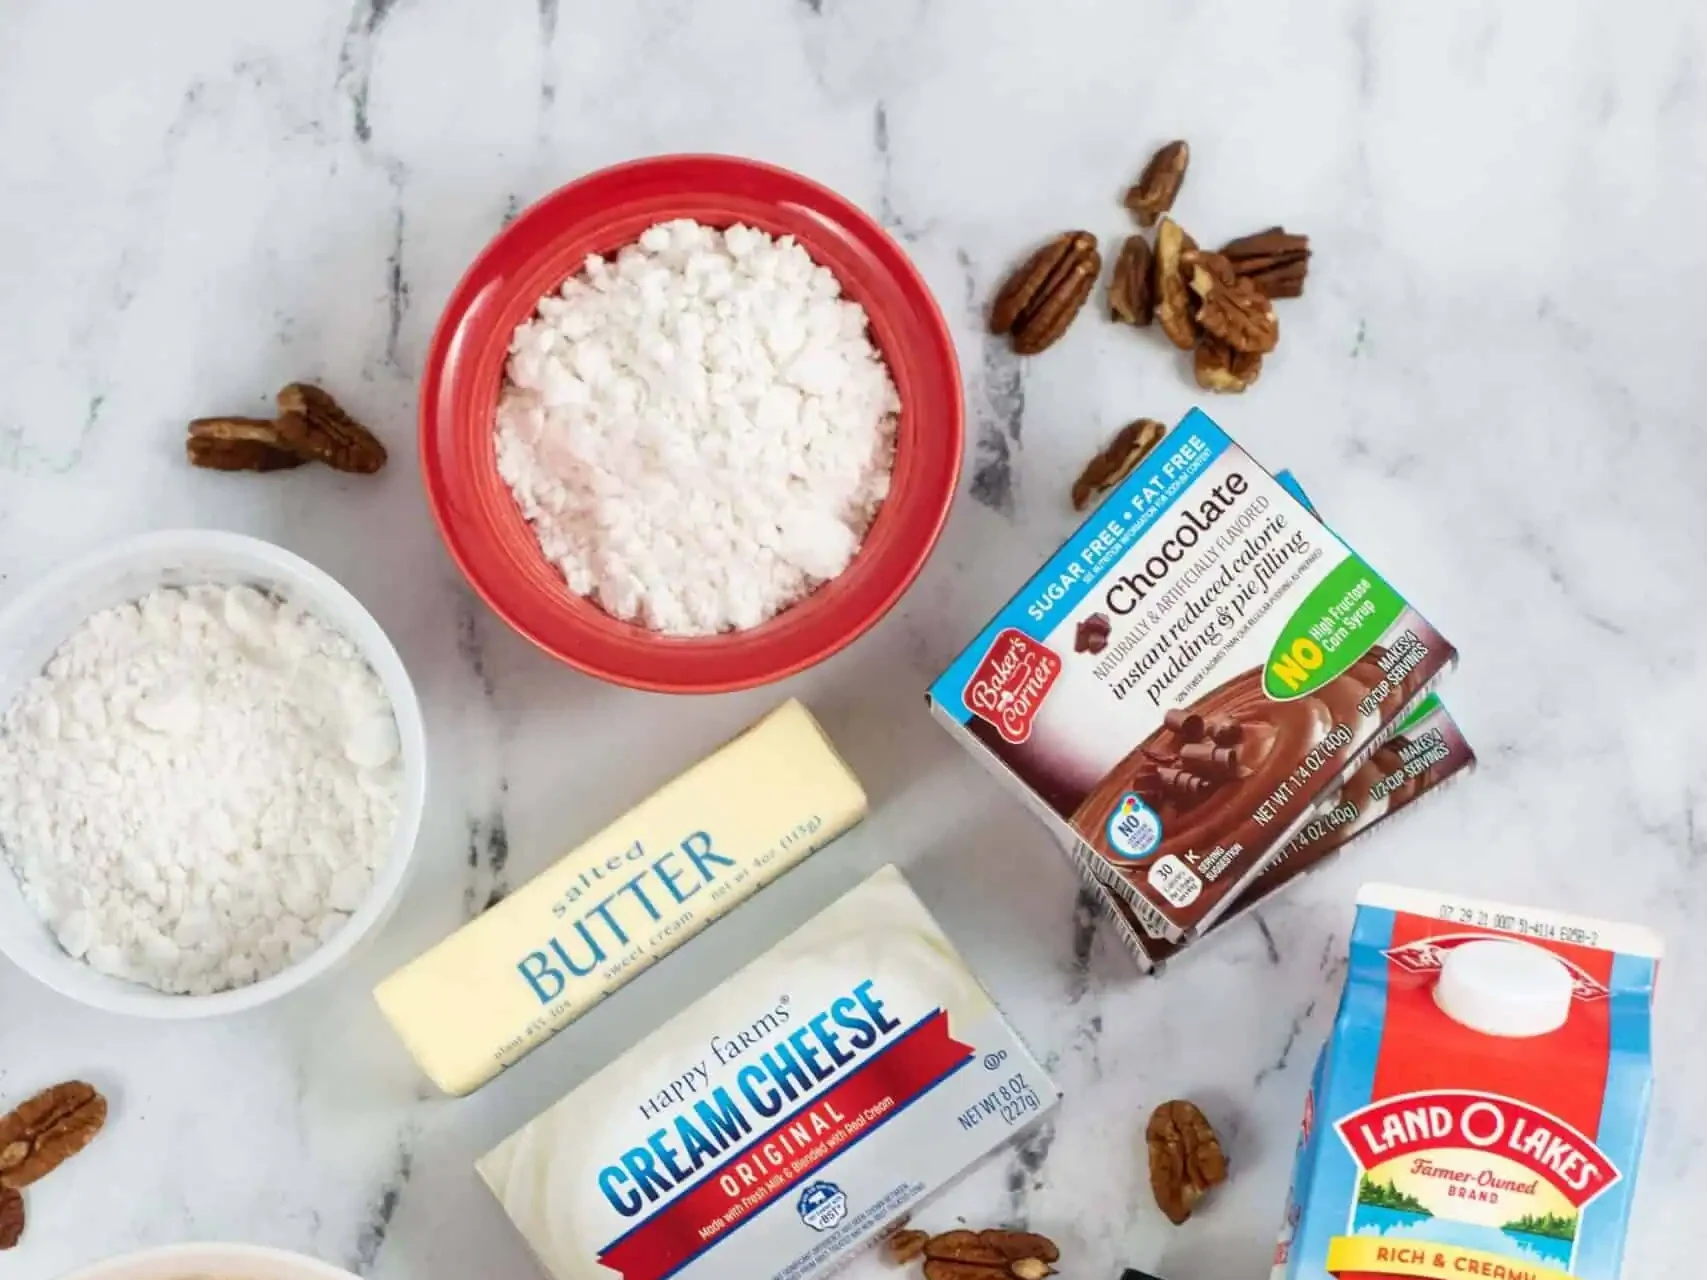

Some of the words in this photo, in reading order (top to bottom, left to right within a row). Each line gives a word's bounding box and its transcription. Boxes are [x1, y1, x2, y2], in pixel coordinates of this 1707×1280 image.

[1027, 561, 1086, 621] SUGAR
[1081, 520, 1125, 565] FREE
[1131, 475, 1166, 512] FAT
[1161, 434, 1206, 479] FREE
[1106, 472, 1248, 615] Chocolate
[1093, 621, 1150, 681] NATURALLY
[1149, 608, 1163, 625] &
[1158, 545, 1219, 612] ARTIFICIALLY
[1215, 495, 1270, 553] FLAVORED
[1108, 635, 1171, 701] instant
[1169, 565, 1234, 643] reduced
[1232, 512, 1289, 576] calorie
[1146, 620, 1225, 707] pudding
[1216, 605, 1235, 630] &
[1230, 582, 1261, 617] pie
[1256, 531, 1311, 594] filling
[1308, 614, 1336, 641] High
[1328, 578, 1372, 624] Fructose
[1322, 624, 1353, 653] Corn
[1348, 600, 1376, 635] Syrup
[1377, 635, 1411, 673] MAKES
[972, 637, 1026, 711] Baker's
[1003, 655, 1052, 736] Corner
[1272, 637, 1324, 691] NO
[1390, 642, 1429, 686] SERVINGS
[1252, 799, 1277, 827] NET
[1270, 783, 1295, 808] WT
[1289, 766, 1312, 791] 1.4
[1305, 751, 1327, 774] OZ
[1320, 724, 1353, 759] (40g)
[1400, 732, 1436, 764] MAKES
[1403, 742, 1451, 779] SERVINGS
[1116, 814, 1141, 838] NO
[1306, 820, 1329, 843] OZ
[1324, 801, 1360, 832] (40g)
[551, 839, 646, 919] salted
[1155, 862, 1174, 881] 30
[516, 830, 737, 1005] BUTTER
[597, 1086, 753, 1218] CREAM
[736, 978, 902, 1118] CHEESE
[957, 1104, 984, 1130] NET
[978, 1091, 1002, 1115] WT
[999, 1085, 1012, 1101] 8
[1008, 1073, 1029, 1094] OZ
[1000, 1089, 1041, 1126] (227g)
[698, 1217, 728, 1241] Made
[723, 1202, 746, 1223] with
[740, 1184, 770, 1210] Fresh
[826, 1128, 848, 1149] with
[844, 1113, 868, 1137] Real
[864, 1095, 896, 1120] Cream
[719, 1101, 846, 1198] ORIGINAL
[1360, 1106, 1453, 1155] LAND
[1460, 1101, 1505, 1146] O
[1507, 1117, 1599, 1191] LAKES
[1410, 1157, 1539, 1197] Farmer-Owned
[1448, 1185, 1500, 1205] BRAND
[1376, 1247, 1425, 1265] RICH
[1433, 1252, 1448, 1269] &
